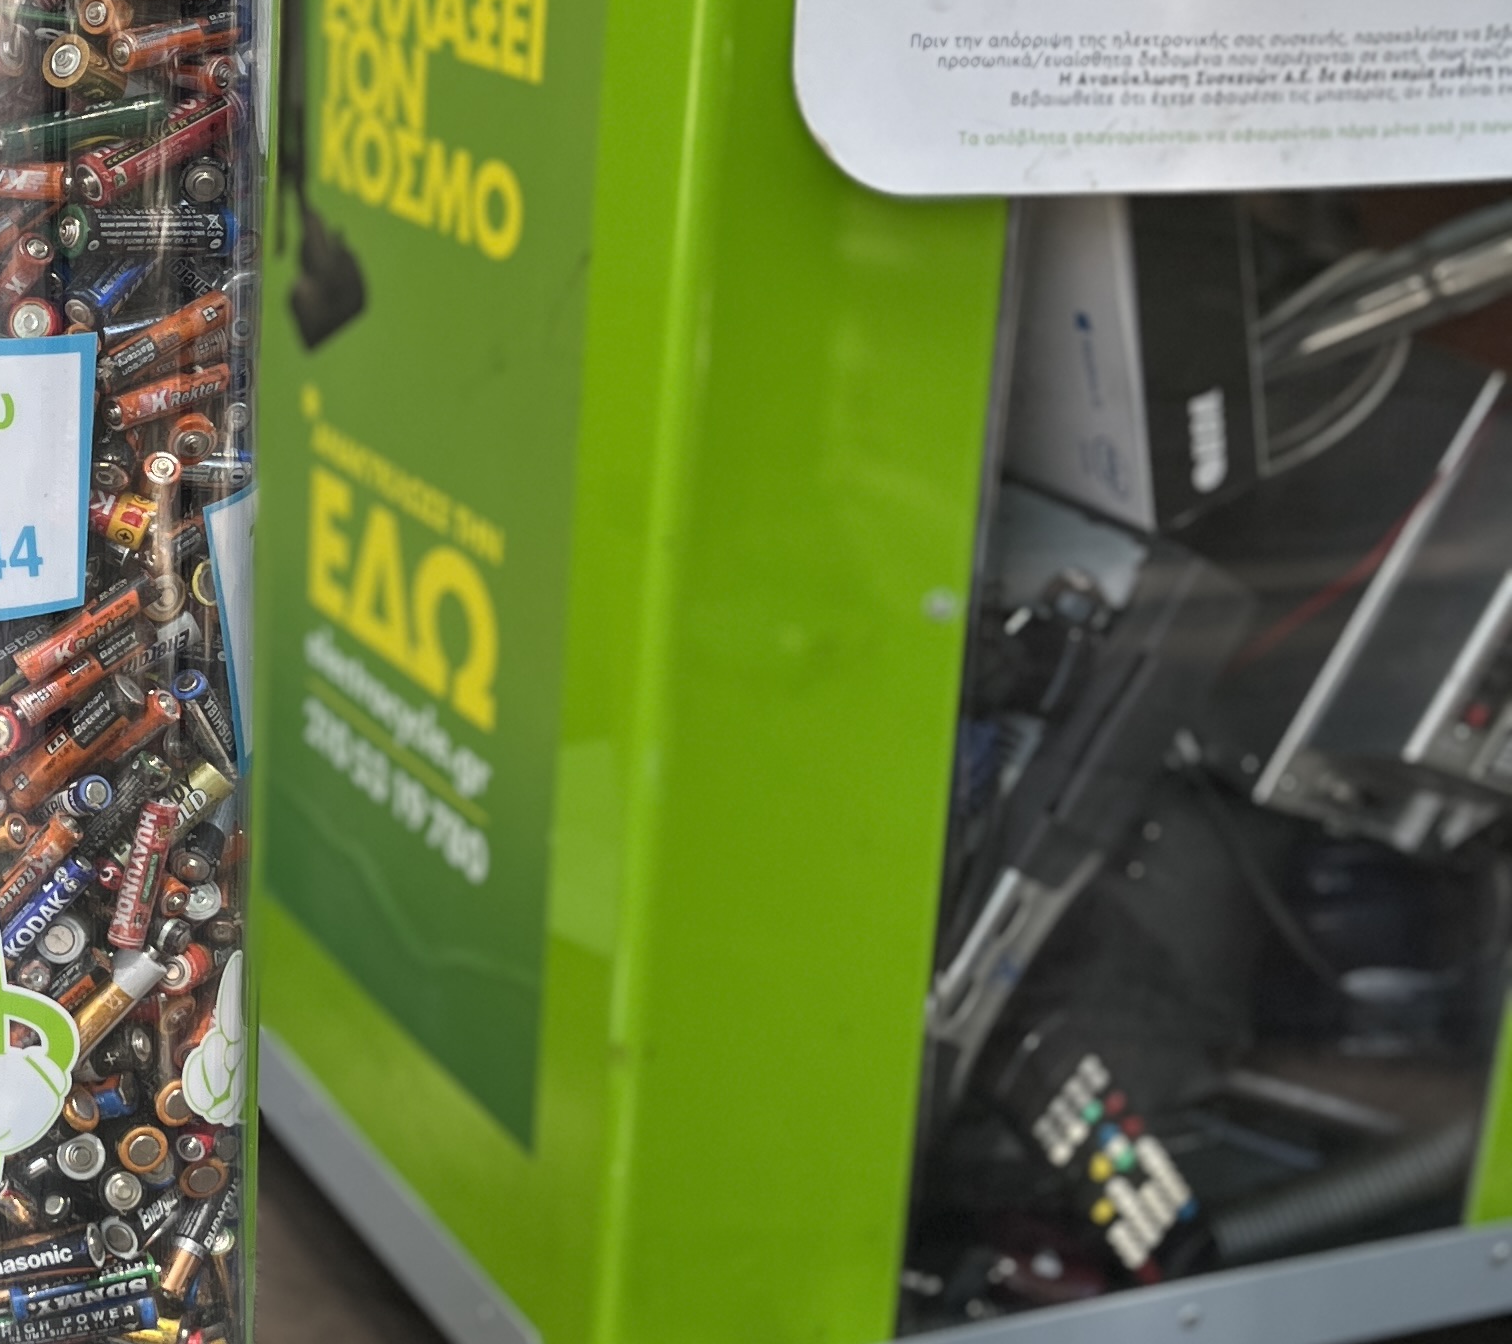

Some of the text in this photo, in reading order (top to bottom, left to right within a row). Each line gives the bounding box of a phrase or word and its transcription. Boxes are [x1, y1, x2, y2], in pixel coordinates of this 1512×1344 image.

[910, 32, 948, 51] Πριν
[955, 35, 983, 51] την
[988, 31, 1073, 51] απόρριψη
[1079, 34, 1107, 50] της
[938, 50, 1133, 70] προσωπικά/ευαίσθητα
[322, 19, 430, 142] ΤΟΝ
[958, 129, 979, 146] Τα
[319, 101, 524, 261] ΚΟΣΜΟ
[170, 380, 221, 407] Rekter
[308, 464, 500, 733] ΕΔΩ
[204, 696, 234, 752] TOSHIBA
[112, 810, 157, 931] HUAYUNOK
[4, 890, 71, 958] KODAK
[1, 1305, 135, 1338] HIGH POWER
